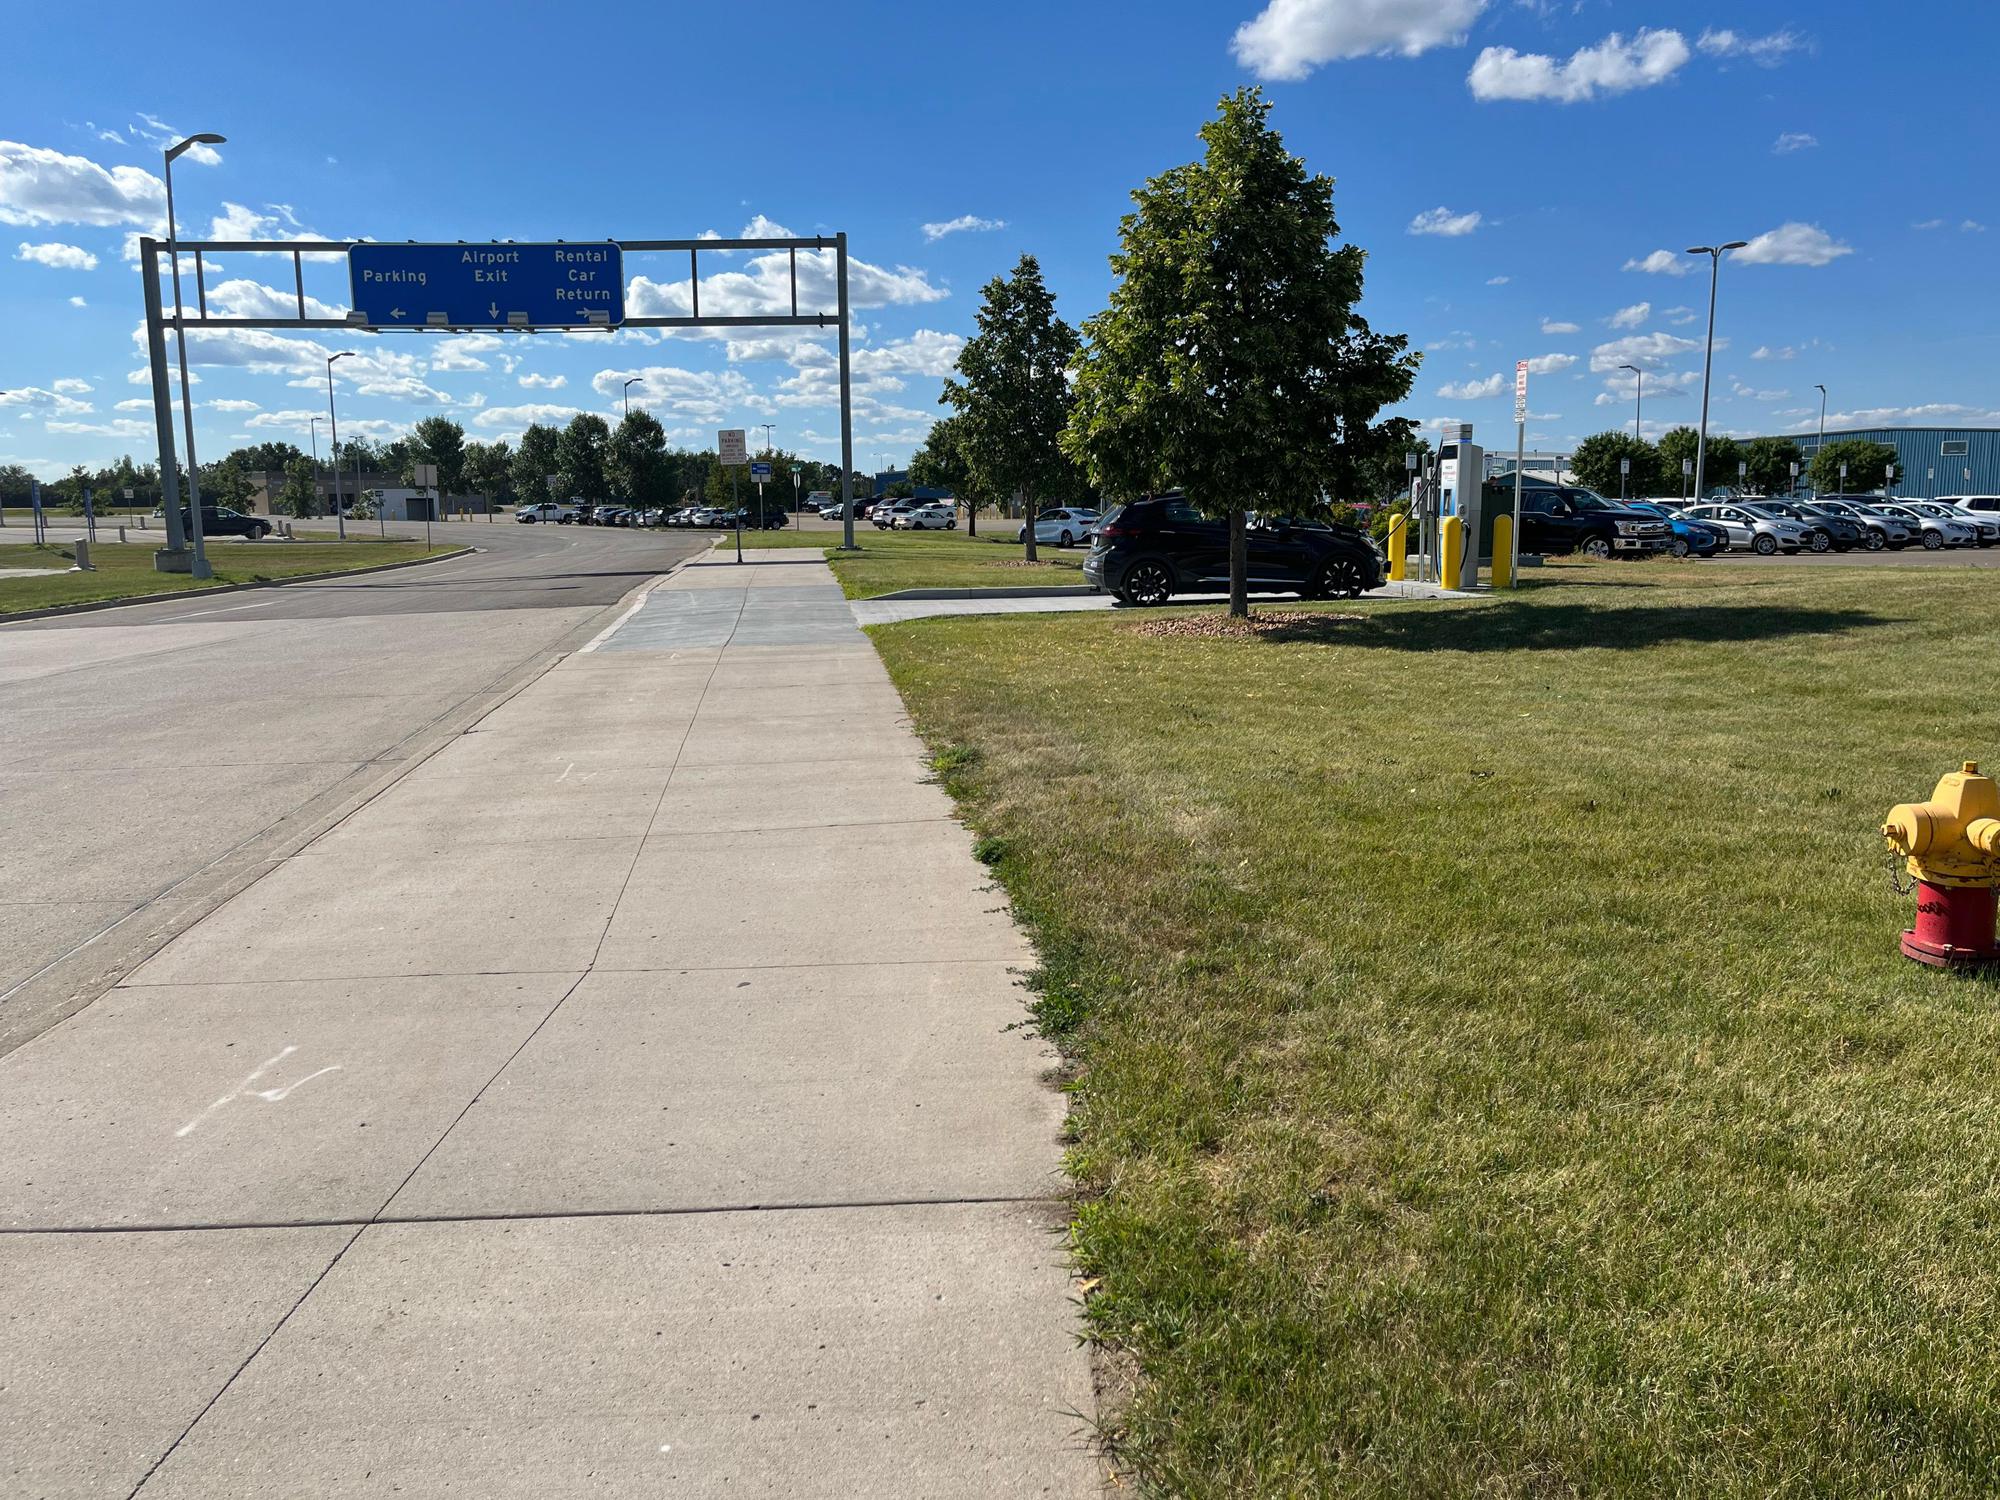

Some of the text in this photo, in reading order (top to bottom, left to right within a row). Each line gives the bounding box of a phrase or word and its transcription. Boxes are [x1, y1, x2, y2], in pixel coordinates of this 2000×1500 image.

[462, 251, 519, 265] Airport
[556, 250, 607, 262] Rental
[364, 270, 427, 285] Parking
[476, 270, 508, 282] Exit
[569, 270, 596, 281] Car
[557, 289, 610, 300] Return
